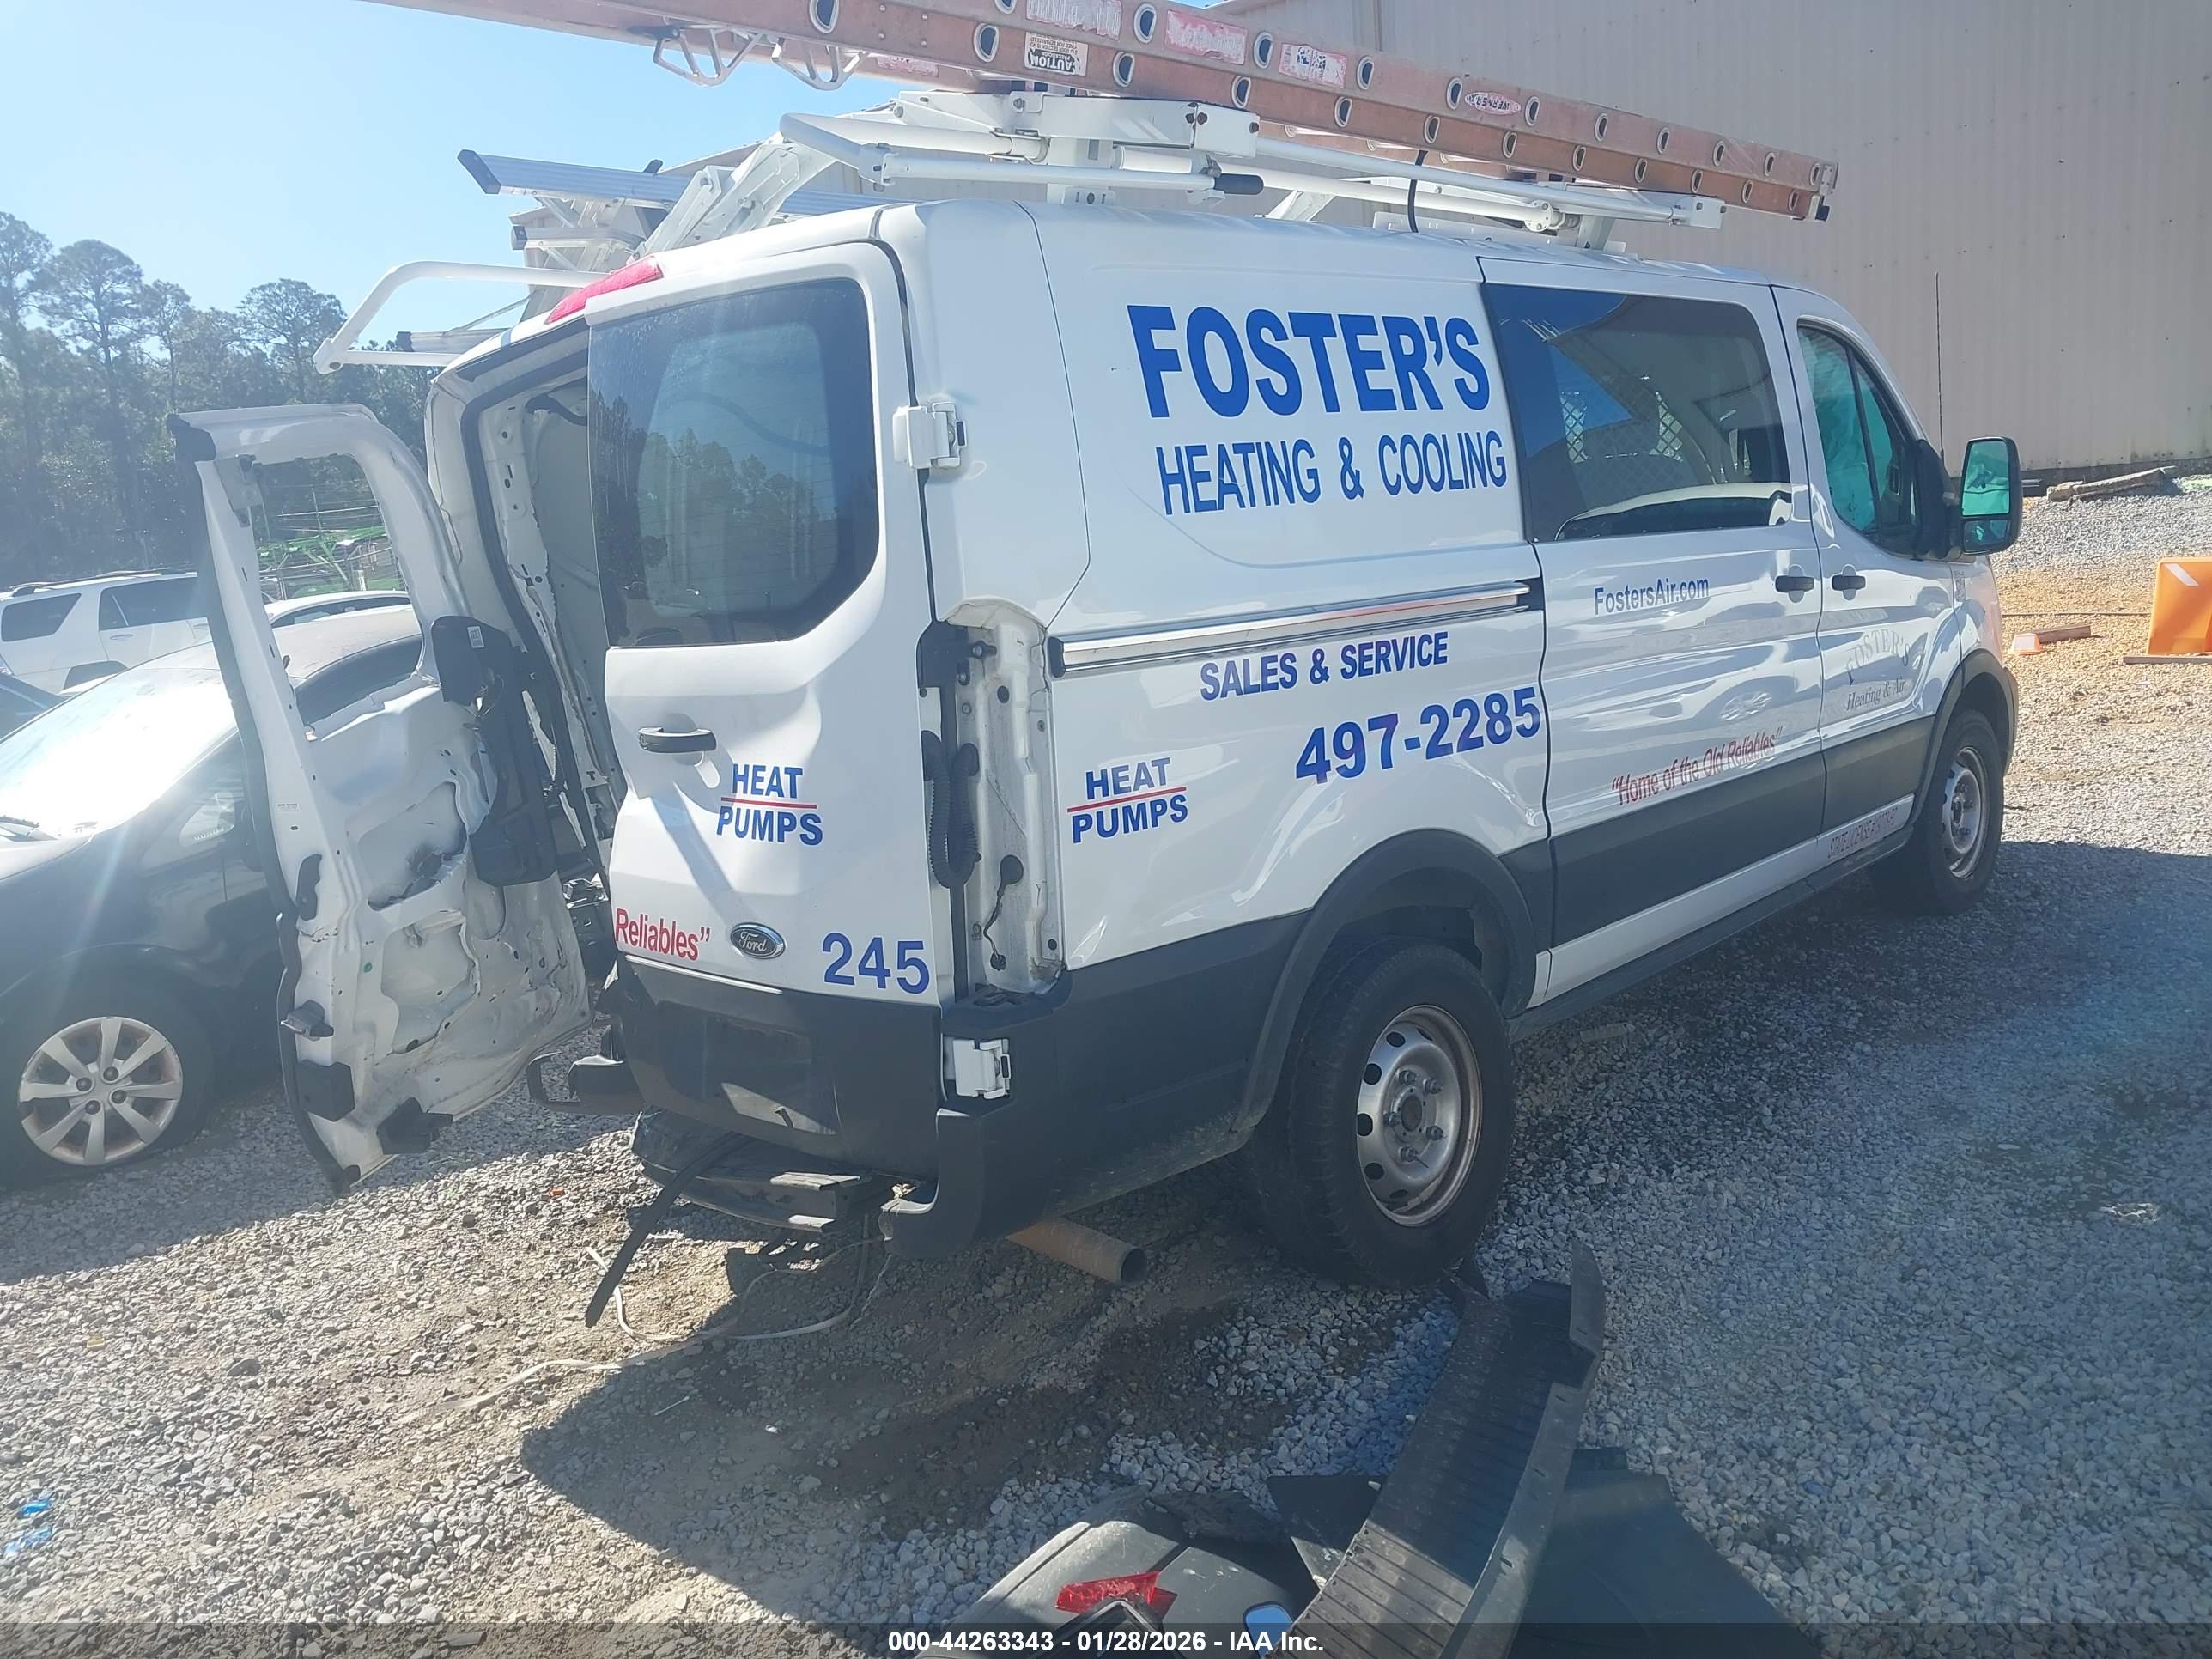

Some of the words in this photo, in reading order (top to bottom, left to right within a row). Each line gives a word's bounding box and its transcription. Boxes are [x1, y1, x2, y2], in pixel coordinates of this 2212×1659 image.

[1126, 305, 1490, 419] FOSTER'S
[1156, 439, 1322, 516] HEATING
[1338, 436, 1364, 500] &
[1378, 430, 1508, 496] COOLING
[1594, 578, 1709, 616] FostersAir.com
[1200, 652, 1297, 701] SALES
[1310, 648, 1329, 684] &
[1340, 631, 1449, 680] SERVICE
[1846, 687, 1881, 711] Heating
[1883, 680, 1891, 697] &
[1296, 687, 1540, 785] 497-2285
[732, 763, 804, 799] HEAT
[1085, 757, 1170, 799] HEAT
[1612, 774, 1659, 806] "Home
[1663, 759, 1678, 790] of
[1680, 756, 1698, 786] the
[1703, 744, 1725, 776] Old
[717, 806, 823, 846] PUMPS
[1073, 794, 1188, 843] PUMPS
[739, 930, 768, 953] Ford
[822, 933, 930, 994] 245
